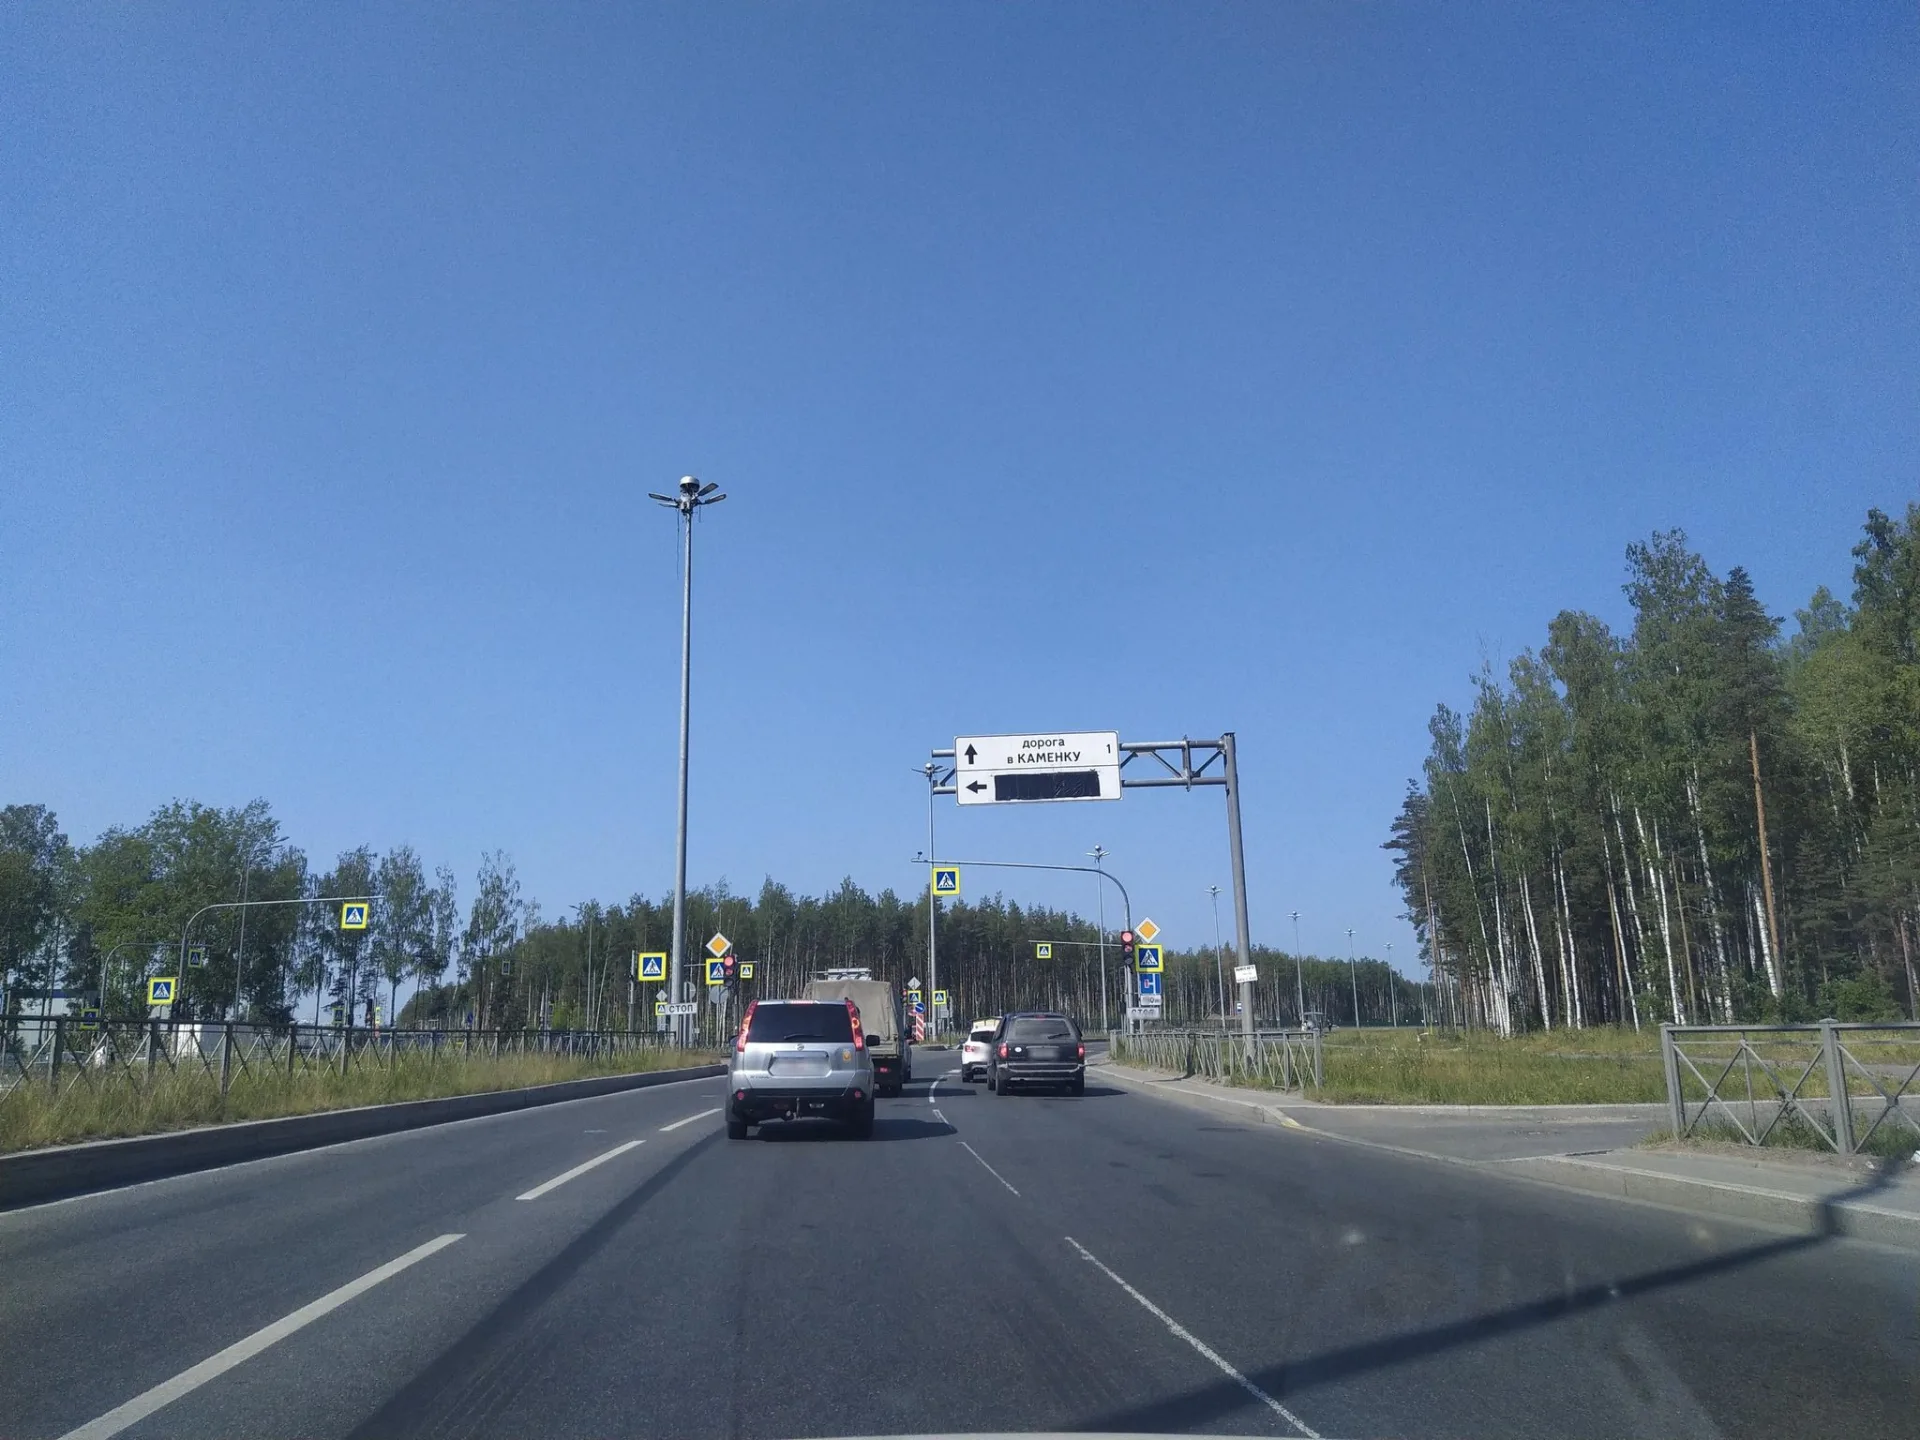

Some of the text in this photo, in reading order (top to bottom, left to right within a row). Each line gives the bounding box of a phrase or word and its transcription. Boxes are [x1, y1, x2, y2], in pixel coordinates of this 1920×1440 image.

[1022, 738, 1065, 750] дорога
[1106, 743, 1111, 754] 1
[1007, 751, 1081, 764] в КАМЕНКУ
[668, 1004, 693, 1013] СТОП
